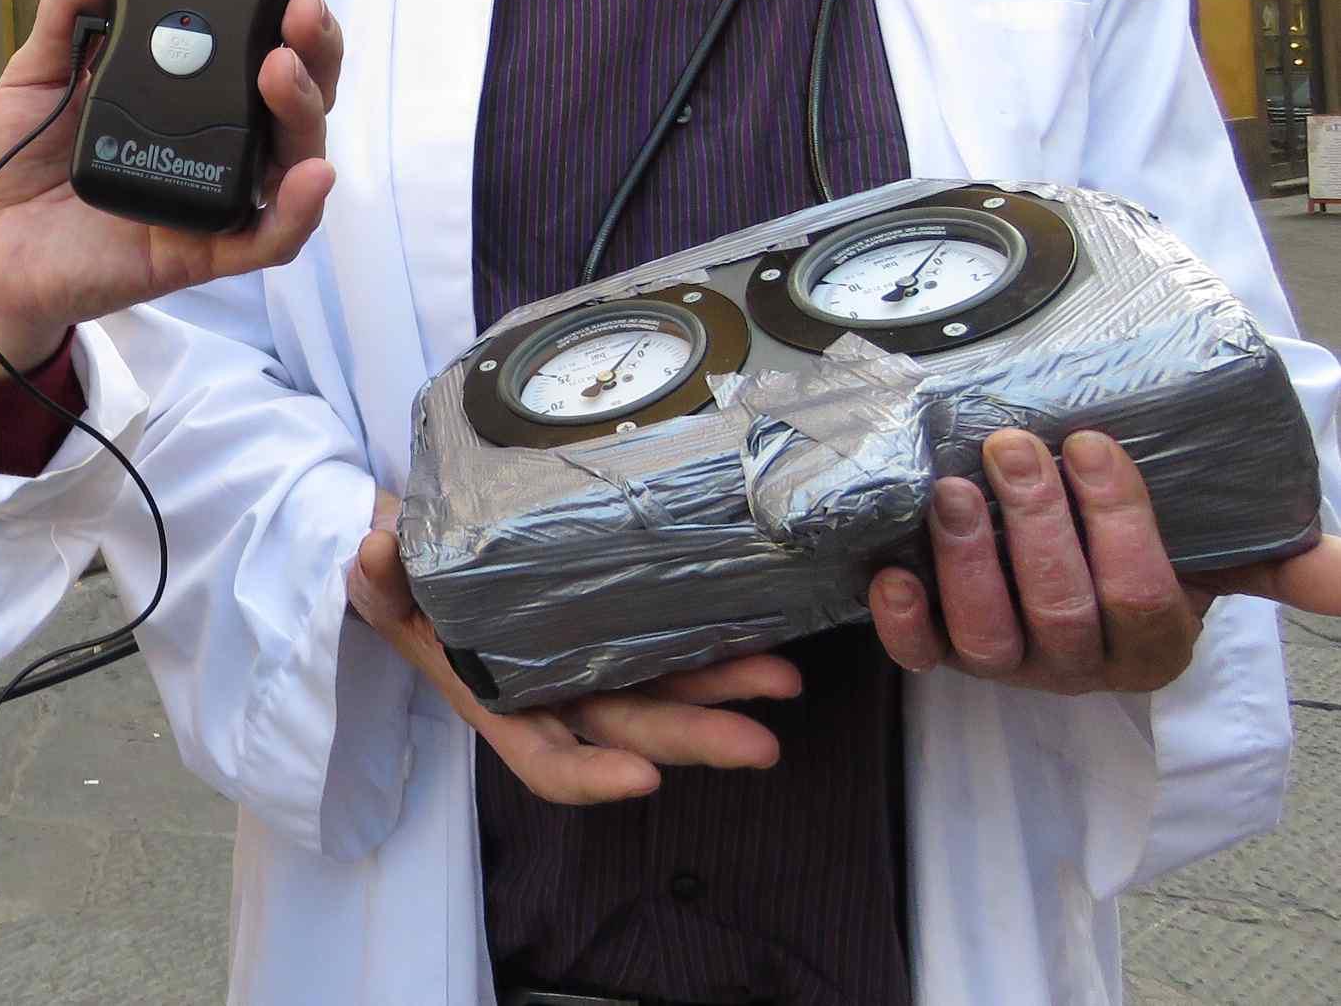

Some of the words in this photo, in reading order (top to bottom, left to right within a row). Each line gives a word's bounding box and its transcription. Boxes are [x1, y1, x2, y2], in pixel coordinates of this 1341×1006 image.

[120, 140, 227, 182] CellSensor
[848, 283, 862, 292] 10
[664, 368, 672, 376] 5
[550, 400, 565, 412] 20
